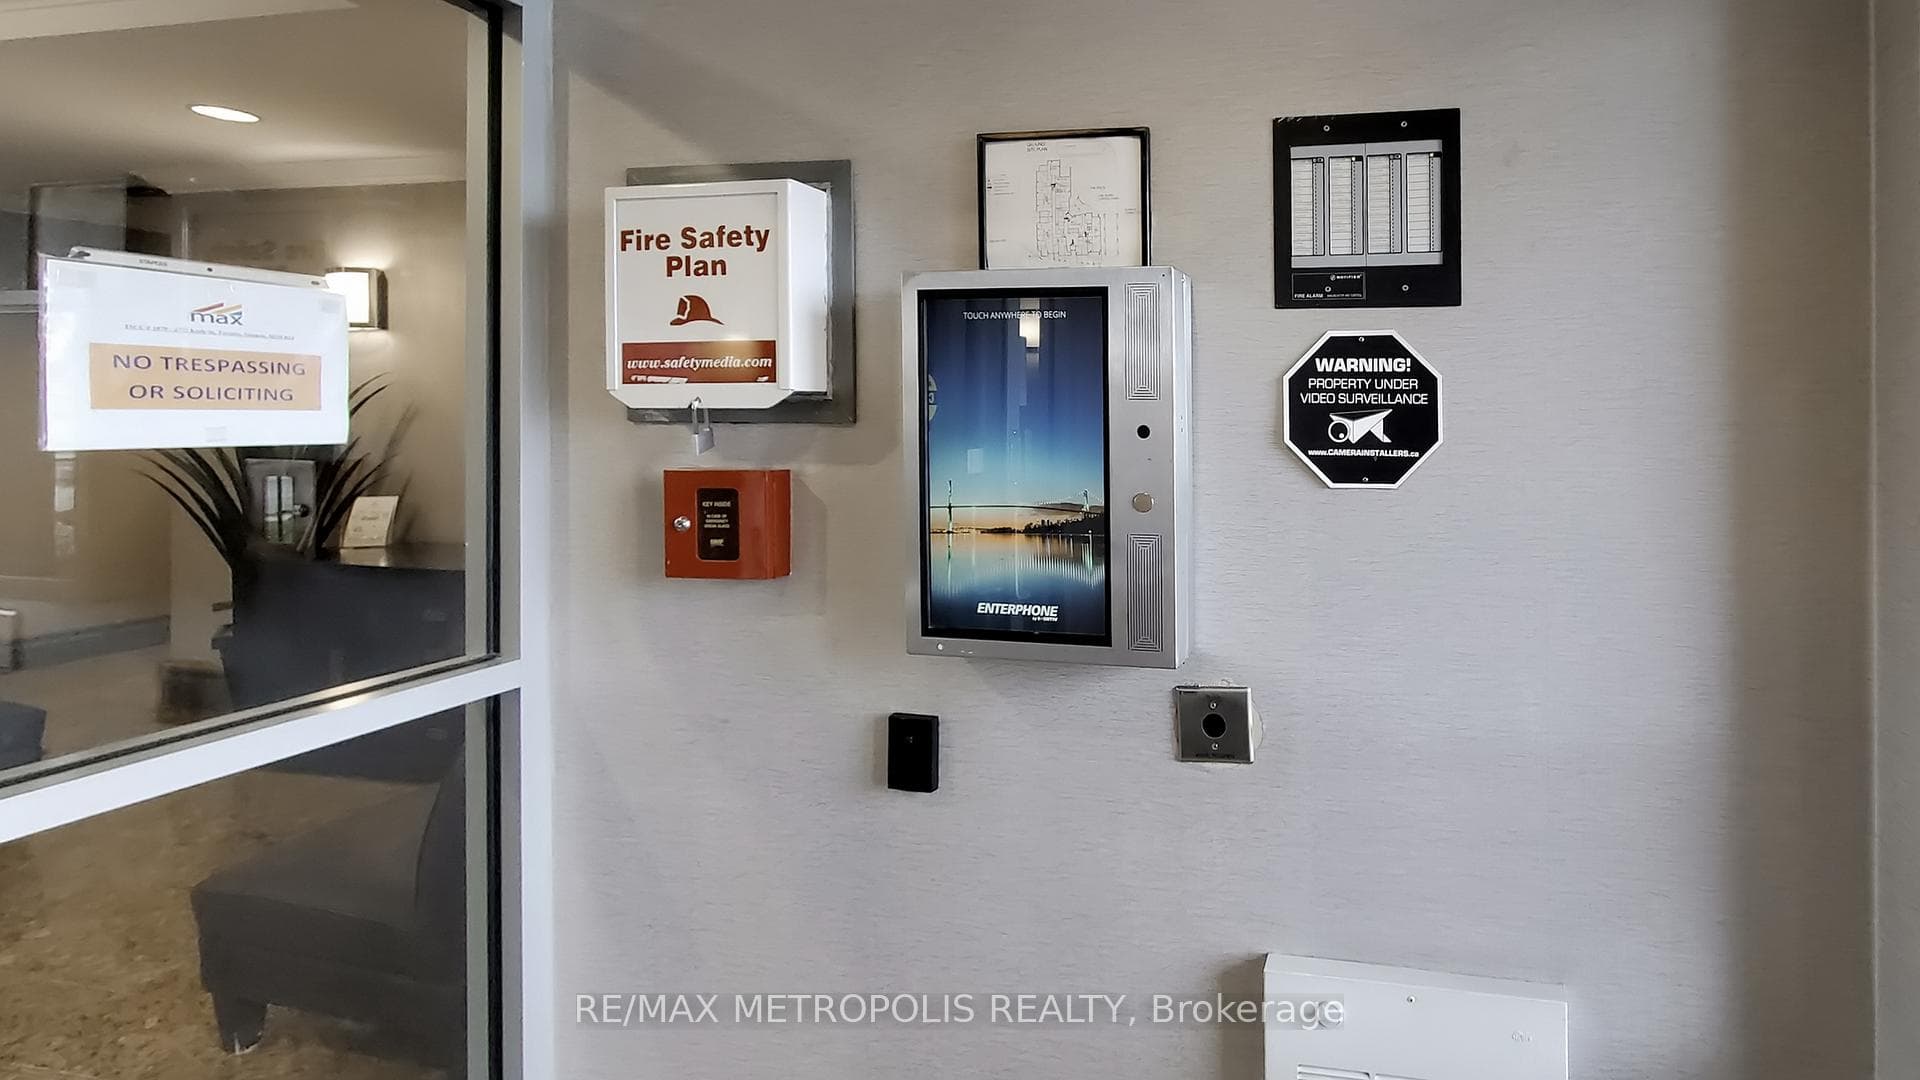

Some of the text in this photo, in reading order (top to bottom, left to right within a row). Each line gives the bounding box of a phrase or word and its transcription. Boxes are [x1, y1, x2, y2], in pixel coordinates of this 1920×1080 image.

[620, 225, 770, 252] Fire Safety
[666, 255, 727, 277] Plan
[190, 309, 243, 326] max
[963, 310, 1067, 320] TOUCH ANYWHERE TO BEGIN
[113, 354, 306, 376] NO TRESPASSING
[627, 355, 772, 371] www.safetymedia.com
[1315, 358, 1411, 372] WARNING!
[1308, 378, 1418, 390] PROPERTY UNDER
[129, 385, 294, 401] OR SOLICITING
[1300, 392, 1428, 404] VIDEO SURVEILLANCE
[1308, 449, 1420, 457] www.CAMERAINSTALLERS.ca
[977, 602, 1058, 616] ENTERPHONE
